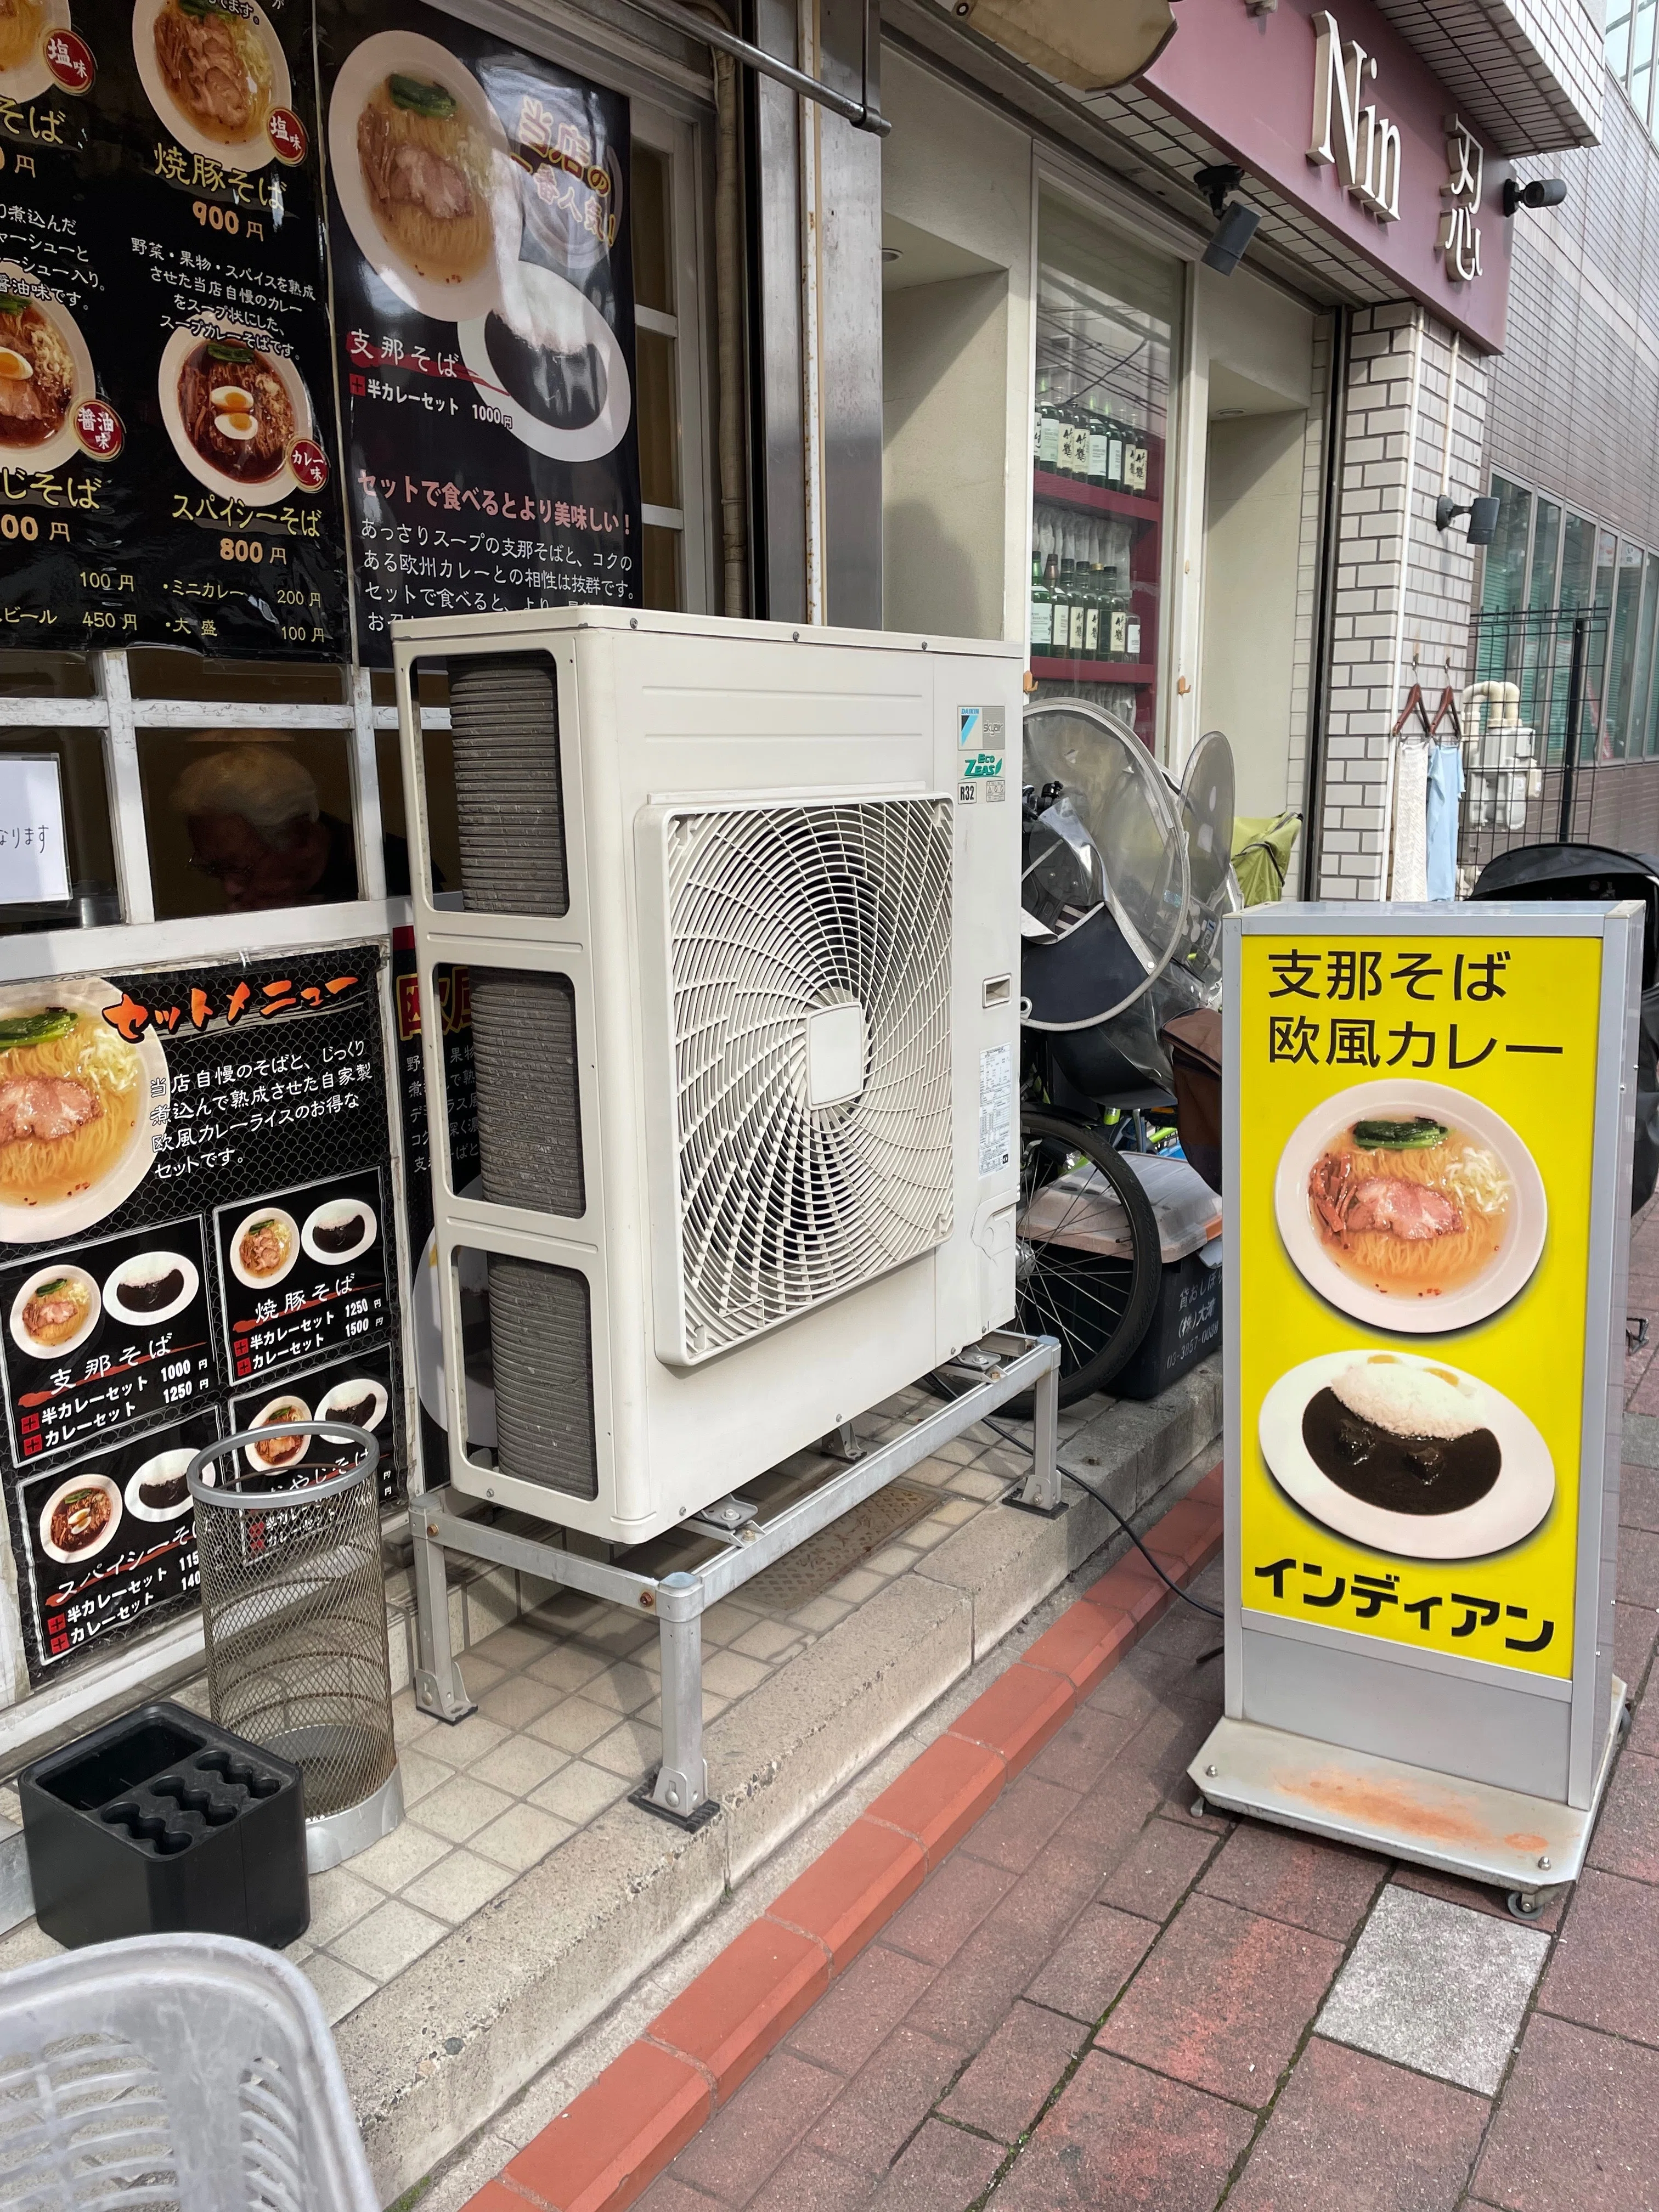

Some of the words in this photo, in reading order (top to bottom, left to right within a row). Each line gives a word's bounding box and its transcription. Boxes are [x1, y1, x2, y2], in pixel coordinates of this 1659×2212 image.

[48, 38, 87, 78] 塩味
[270, 116, 302, 151] 塩味
[1312, 10, 1401, 221] Nin
[154, 143, 287, 210] 焼豚そば
[150, 267, 302, 313] させた当店自慢のカレー
[174, 294, 285, 336] をスープ状にした、
[160, 315, 300, 360] スープカレーそばです。
[350, 328, 459, 379] 支那そば
[368, 379, 459, 415] 半カレーセット
[172, 494, 322, 537] スパイシーそば
[960, 785, 974, 801] R32
[1268, 949, 1511, 1001] 支那そば
[103, 977, 358, 1039] セットメニュー
[1269, 1015, 1563, 1069] 欧風カレー
[151, 1062, 373, 1126] 煮込んで熟成させた自家製
[152, 1093, 359, 1153] 欧風カレーライスのお得な
[155, 1147, 244, 1180] セットです。
[255, 1273, 355, 1324] 焼豚そば
[50, 1333, 172, 1396] 支那そば
[1255, 1558, 1554, 1651] インディアン
